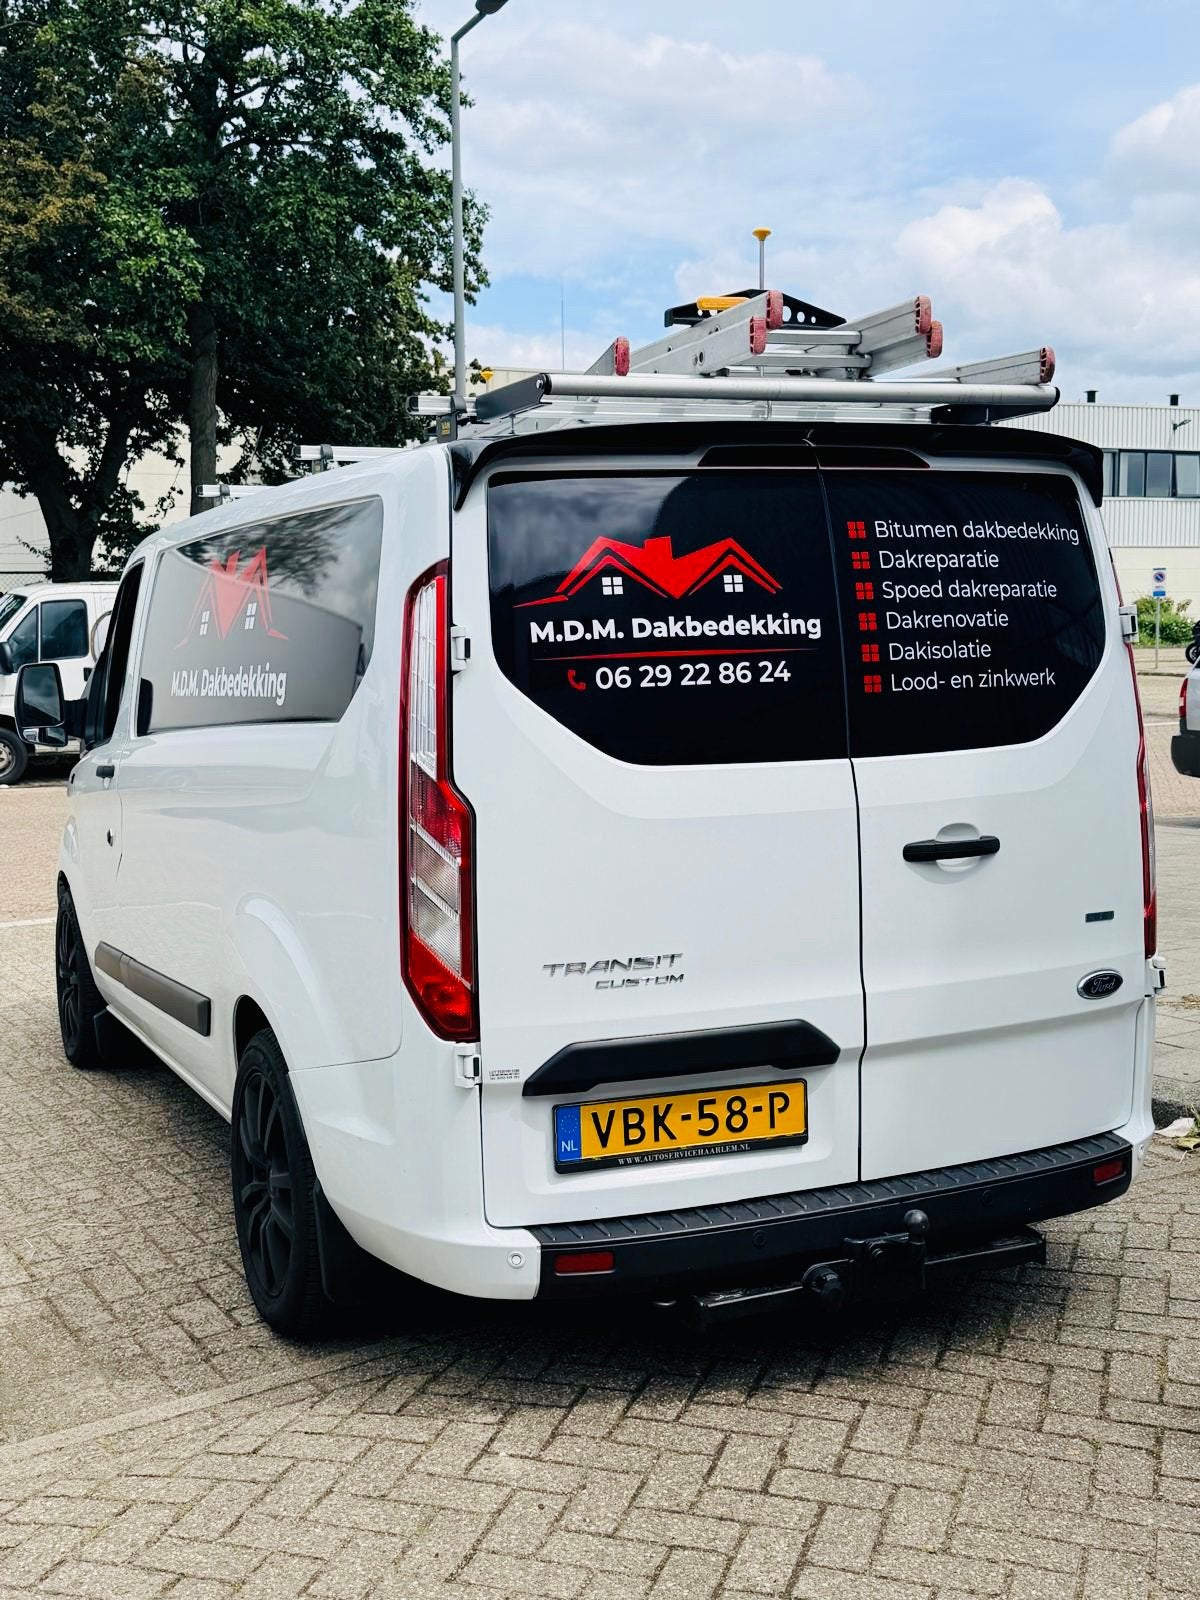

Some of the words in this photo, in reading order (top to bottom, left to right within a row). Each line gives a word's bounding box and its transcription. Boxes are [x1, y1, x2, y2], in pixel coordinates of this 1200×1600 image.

[874, 519, 958, 538] Bitumen
[962, 520, 1080, 546] dakbedekking
[878, 549, 1000, 573] Dakreparatie
[882, 579, 943, 603] Spoed
[948, 579, 1057, 602] dakreparatie
[529, 618, 625, 644] M.D.M.
[631, 612, 822, 640] Dakbedekking
[885, 608, 1009, 630] Dakrenovatie
[888, 639, 992, 661] Dakisolatie
[170, 669, 199, 697] M.D.M.
[200, 662, 287, 706] Dakbedekking
[595, 665, 632, 690] 06
[638, 664, 672, 688] 29
[679, 662, 712, 686] 22
[718, 661, 753, 685] 86
[757, 660, 792, 683] 24
[891, 671, 946, 692] Lood-
[950, 674, 974, 689] en
[978, 667, 1056, 688] zinkwerk
[542, 953, 683, 977] TRANSIT
[594, 973, 685, 990] CUSTOM
[1090, 976, 1116, 994] Ford
[590, 1091, 791, 1149] VBK-58-P
[561, 1139, 579, 1152] NL
[617, 1143, 751, 1166] WWW.AUTOSERVICEHAARLEM.NL
